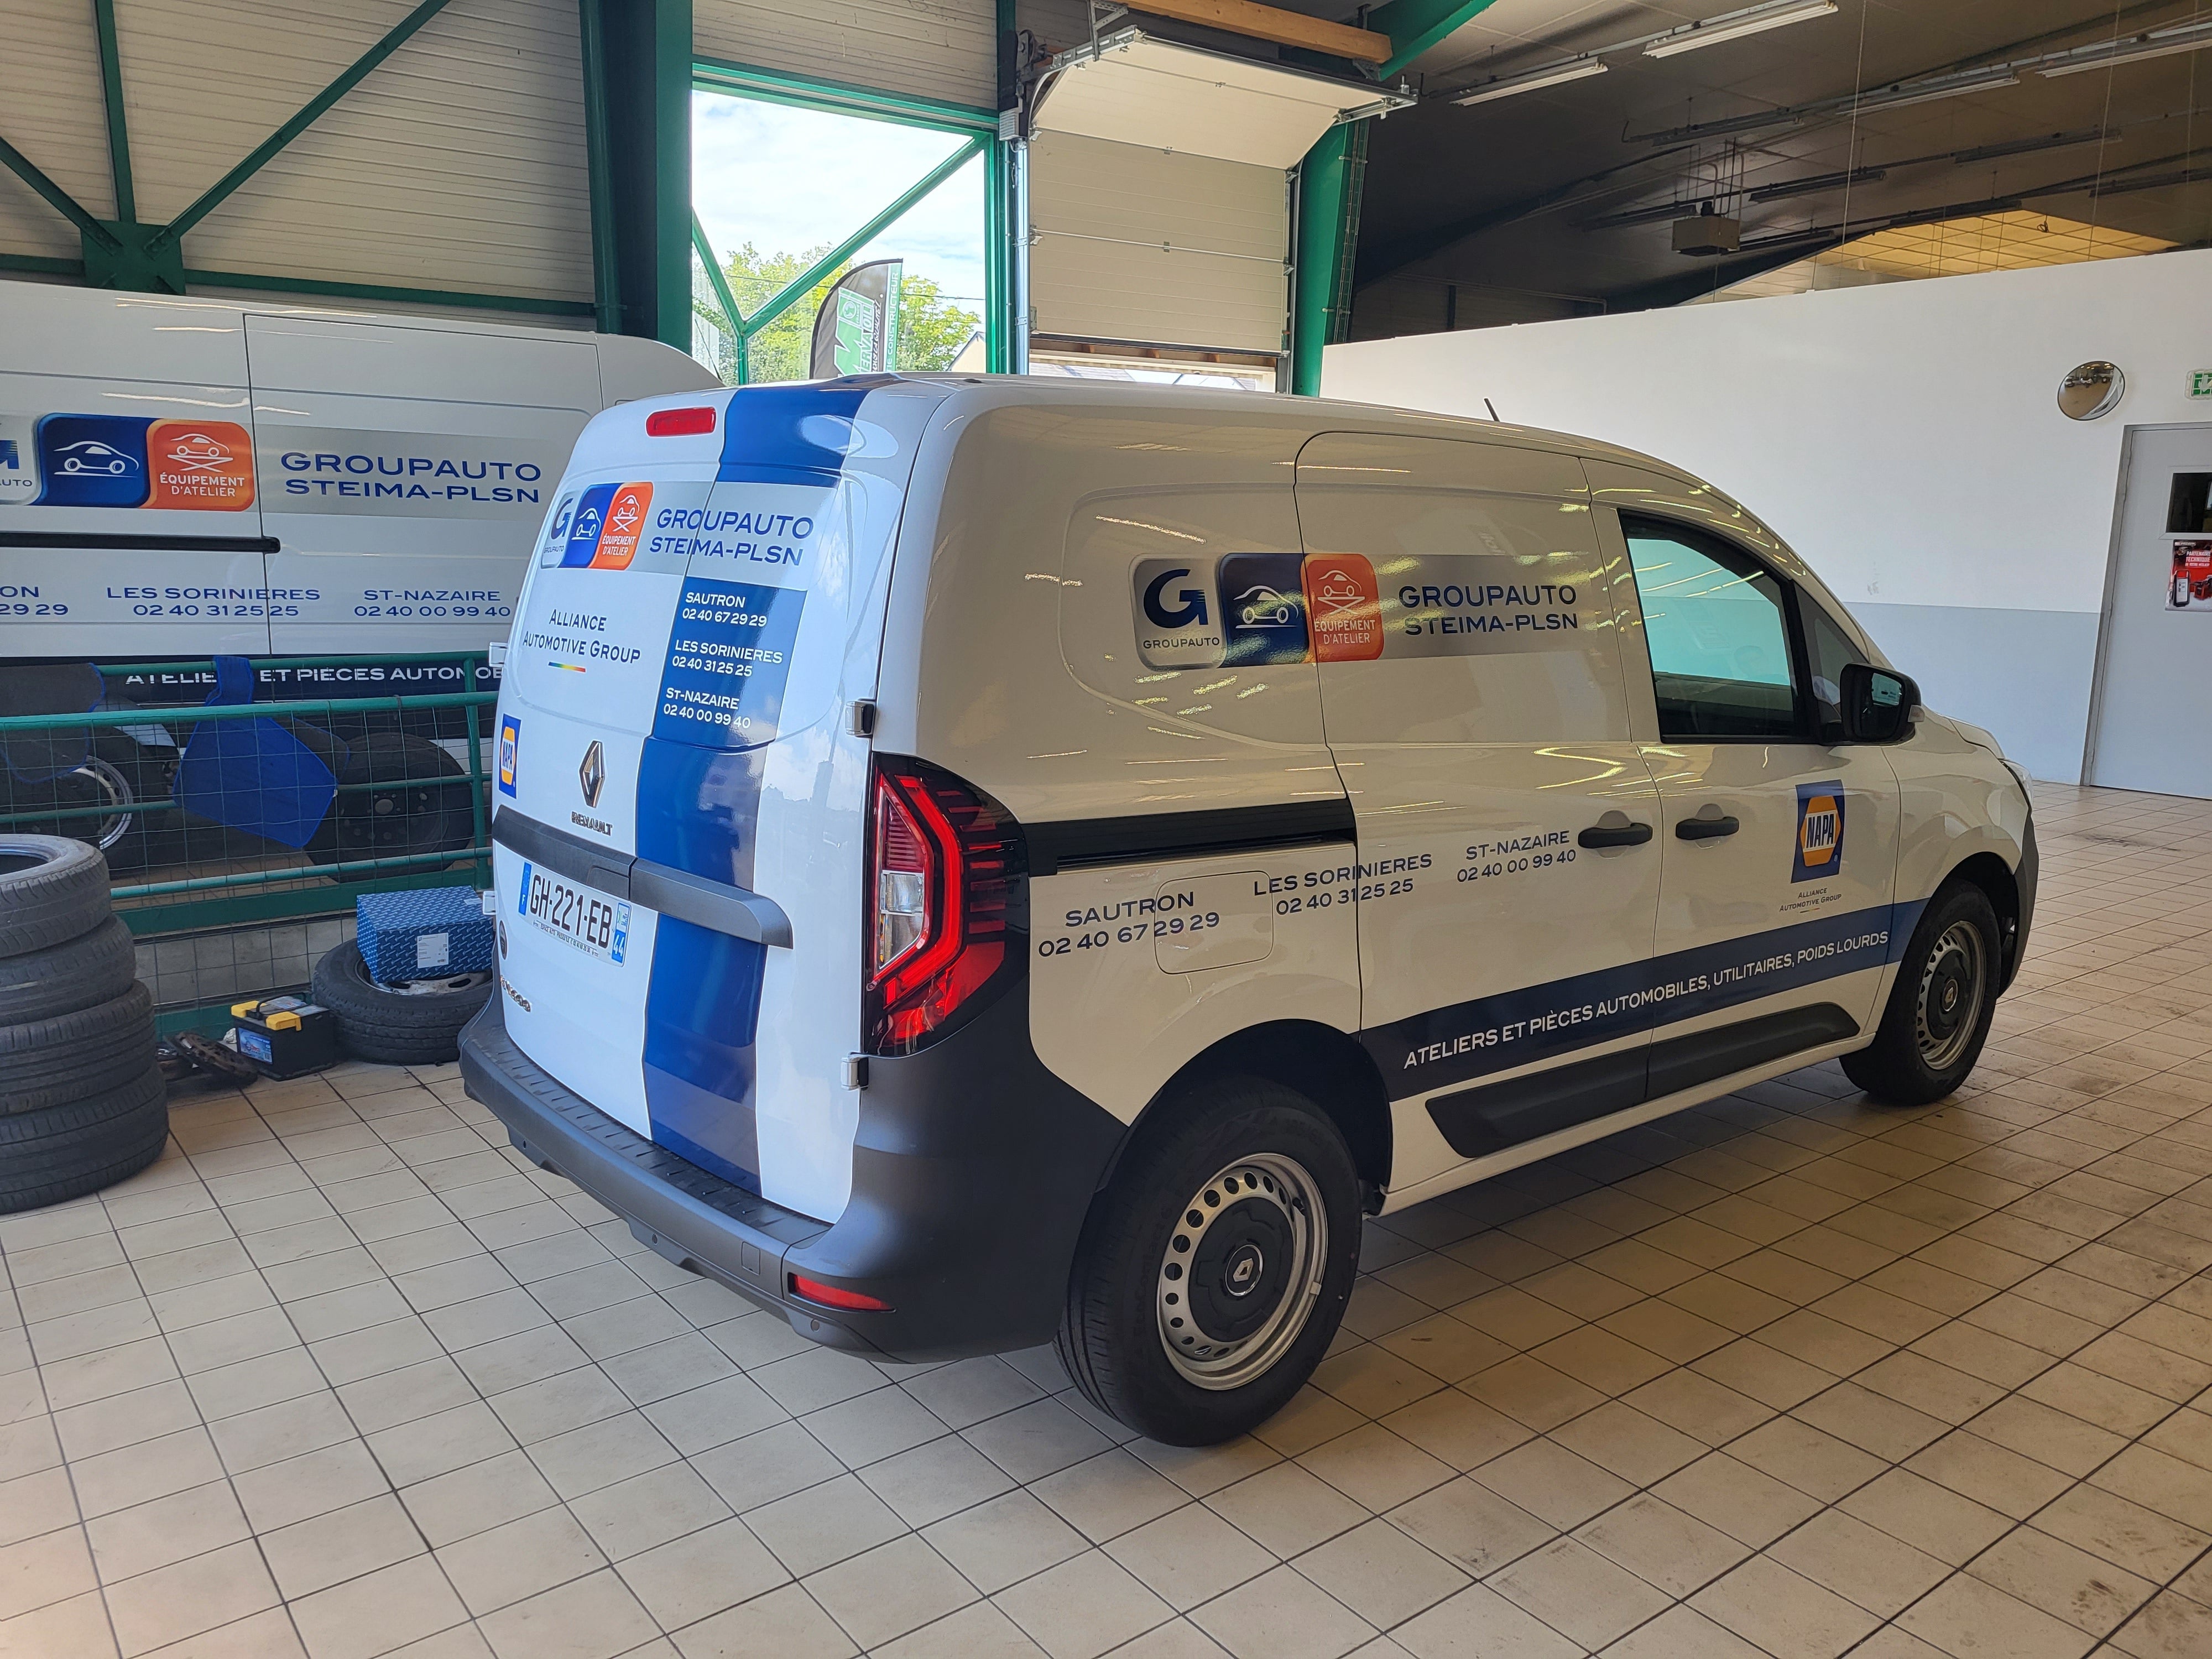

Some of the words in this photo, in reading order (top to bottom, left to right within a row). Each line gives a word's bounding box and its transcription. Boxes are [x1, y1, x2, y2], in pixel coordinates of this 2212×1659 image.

[888, 272, 898, 355] CONSTRUCTEUR
[281, 452, 541, 482] GROUPAUTO
[160, 472, 245, 486] ÉQUIPEMENT
[171, 486, 236, 497] D'ATELIER
[285, 479, 539, 503] STEIMA-PLSN
[657, 508, 814, 539] GROUPAUTO
[602, 535, 637, 545] ÉQUIPEMENT
[602, 546, 628, 556] D'ATELIER
[649, 536, 804, 566] STEIMA-PLSN
[107, 587, 158, 599] LES
[165, 588, 320, 600] SORINIERES
[364, 589, 501, 602] ST-NAZAIRE
[685, 592, 746, 608] SAUTRON
[1399, 585, 1577, 608] GROUPAUTO
[35, 604, 69, 615] 29
[133, 604, 164, 615] 02
[169, 605, 199, 615] 40
[269, 606, 299, 616] 25
[354, 606, 381, 616] 02
[386, 606, 413, 616] 40
[419, 606, 447, 616] 00
[452, 606, 479, 616] 99
[484, 607, 510, 616] 40
[682, 608, 696, 619] 02
[697, 609, 713, 621] 40
[714, 611, 731, 623] 67
[731, 613, 748, 625] 29
[749, 615, 767, 627] 29
[1404, 613, 1578, 635] STEIMA-PLSN
[1143, 637, 1220, 649] GROUPAUTO
[1323, 633, 1370, 645] D'ATELIER
[675, 639, 698, 653] LES
[700, 643, 783, 664] SORINIERES
[260, 669, 291, 682] ET
[672, 656, 686, 668] 02
[687, 658, 702, 670] 40
[735, 664, 753, 677] 25
[663, 703, 678, 716] 02
[679, 706, 694, 719] 40
[696, 709, 712, 722] 00
[714, 712, 731, 726] 99
[733, 716, 751, 729] 40
[503, 741, 513, 771] NAPA
[571, 811, 613, 836] RENAULT
[1806, 813, 1835, 849] NAPA
[1465, 830, 1570, 860] ST-NAZAIRE
[1254, 875, 1297, 896] LES
[1303, 854, 1432, 888] SORINIERES
[1457, 867, 1478, 883] 02
[1481, 862, 1503, 877] 40
[1507, 858, 1528, 873] 00
[1532, 853, 1553, 868] 99
[1556, 849, 1577, 863] 40
[521, 894, 525, 905] F
[1276, 898, 1302, 915] 02
[1306, 893, 1332, 909] 40
[1360, 883, 1385, 901] 25
[1389, 878, 1413, 895] 25
[530, 874, 613, 949] GH-221-EB
[1065, 891, 1194, 927] SAUTRON
[613, 934, 625, 957] 44
[1039, 938, 1071, 957] 02
[1077, 931, 1109, 950] 40
[1117, 923, 1148, 943] 67
[1154, 918, 1184, 937] 29
[1190, 912, 1220, 931] 29
[1404, 1029, 1498, 1070] ATELIERS
[1503, 1021, 1526, 1042] ET
[1530, 1005, 1593, 1035] PIÈCES
[1596, 975, 1711, 1018] AUTOMOBILES,
[1714, 953, 1795, 985] UTILITAIRES,
[1797, 943, 1834, 965] POIDS
[1837, 931, 1888, 953] LOURDS
